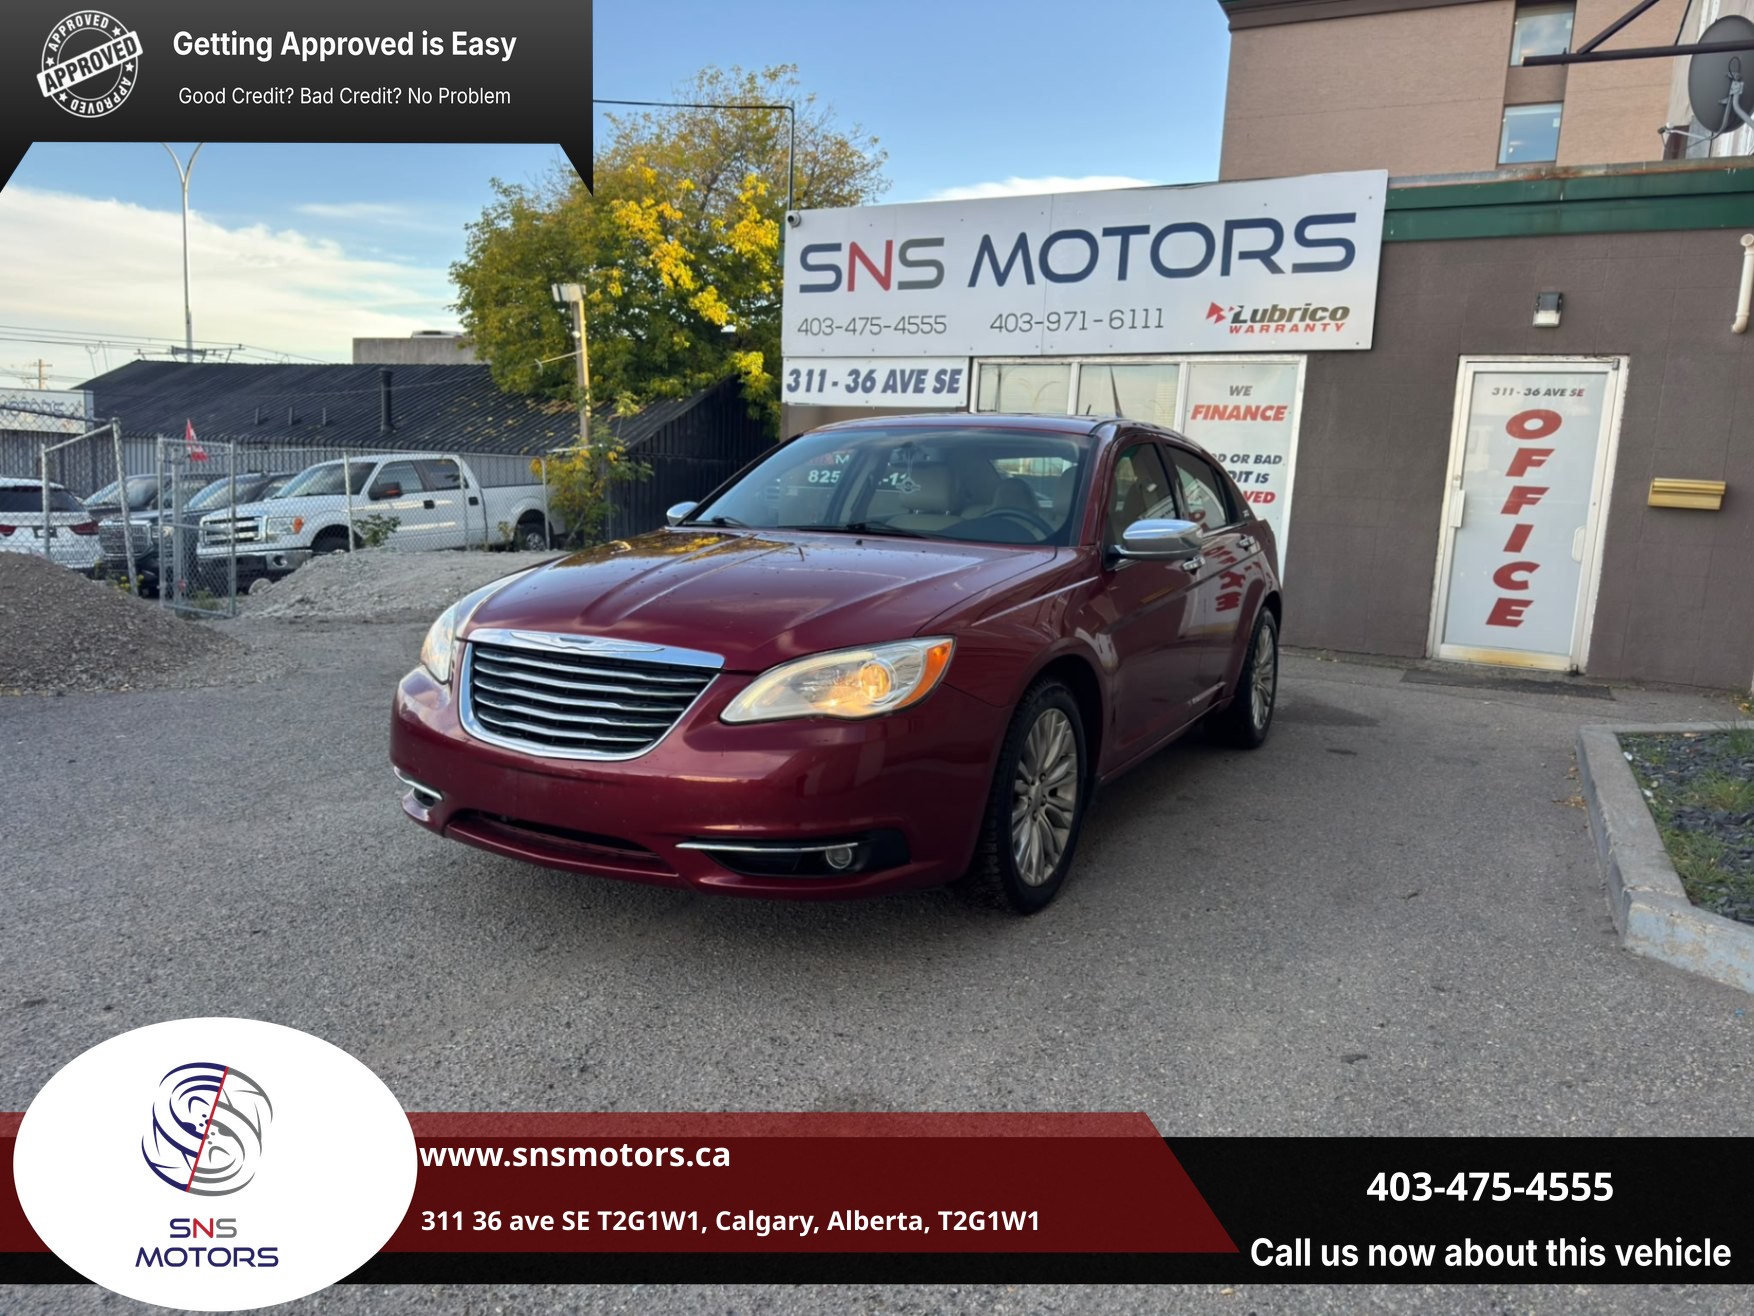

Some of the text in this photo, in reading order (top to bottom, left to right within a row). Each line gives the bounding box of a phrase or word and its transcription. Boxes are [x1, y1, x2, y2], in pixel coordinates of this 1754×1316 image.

[799, 212, 1357, 293] SNS MOTORS
[797, 308, 1164, 336] 403-475-4555 403-971-6111
[1230, 303, 1351, 324] Lubrico
[1229, 323, 1345, 334] WARRANTY
[786, 369, 827, 394] 311
[845, 369, 876, 394] 36
[881, 369, 928, 394] AVE
[933, 369, 963, 394] SE
[1229, 385, 1253, 397] WE
[1492, 387, 1514, 397] 311
[1523, 387, 1540, 397] 36
[1543, 388, 1567, 397] AVE
[1569, 388, 1585, 397] SE
[1190, 404, 1289, 421] FINANCE
[1230, 454, 1250, 464] OR
[1253, 454, 1283, 465] BAD
[1255, 473, 1270, 484] IS
[1485, 408, 1562, 628] OFFICE
